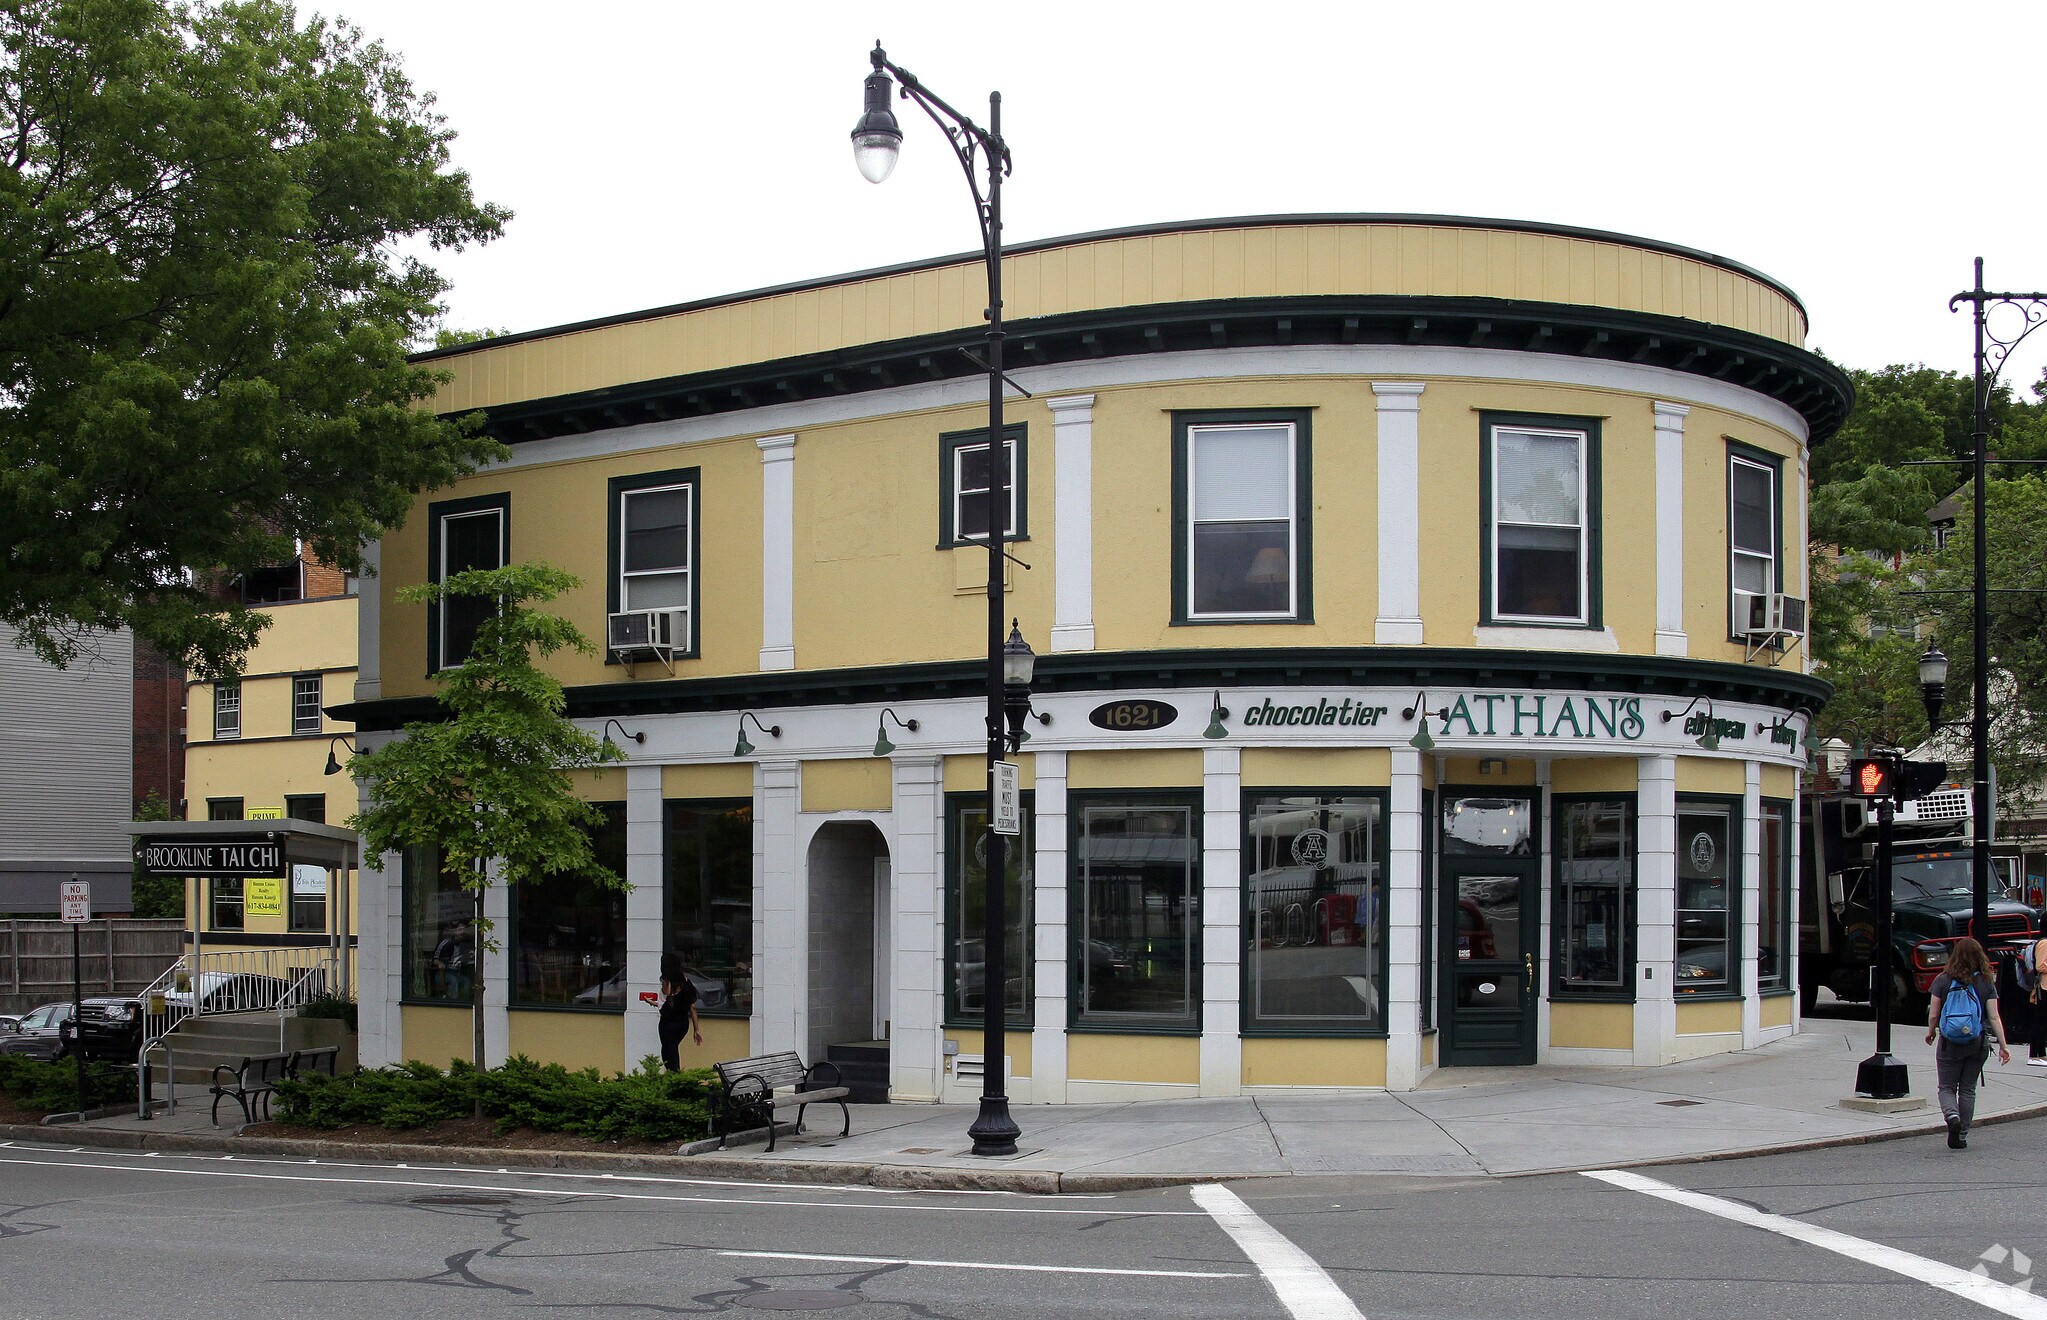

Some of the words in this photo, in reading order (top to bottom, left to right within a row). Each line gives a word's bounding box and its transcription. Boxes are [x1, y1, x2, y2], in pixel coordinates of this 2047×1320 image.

[1106, 704, 1159, 727] 1621
[1243, 697, 1388, 726] chocolatier
[1439, 693, 1645, 740] ATHAN'S
[1002, 791, 1012, 805] MUST
[146, 847, 213, 867] BROOKLINE
[220, 847, 245, 867] TAI
[249, 847, 279, 867] CHI
